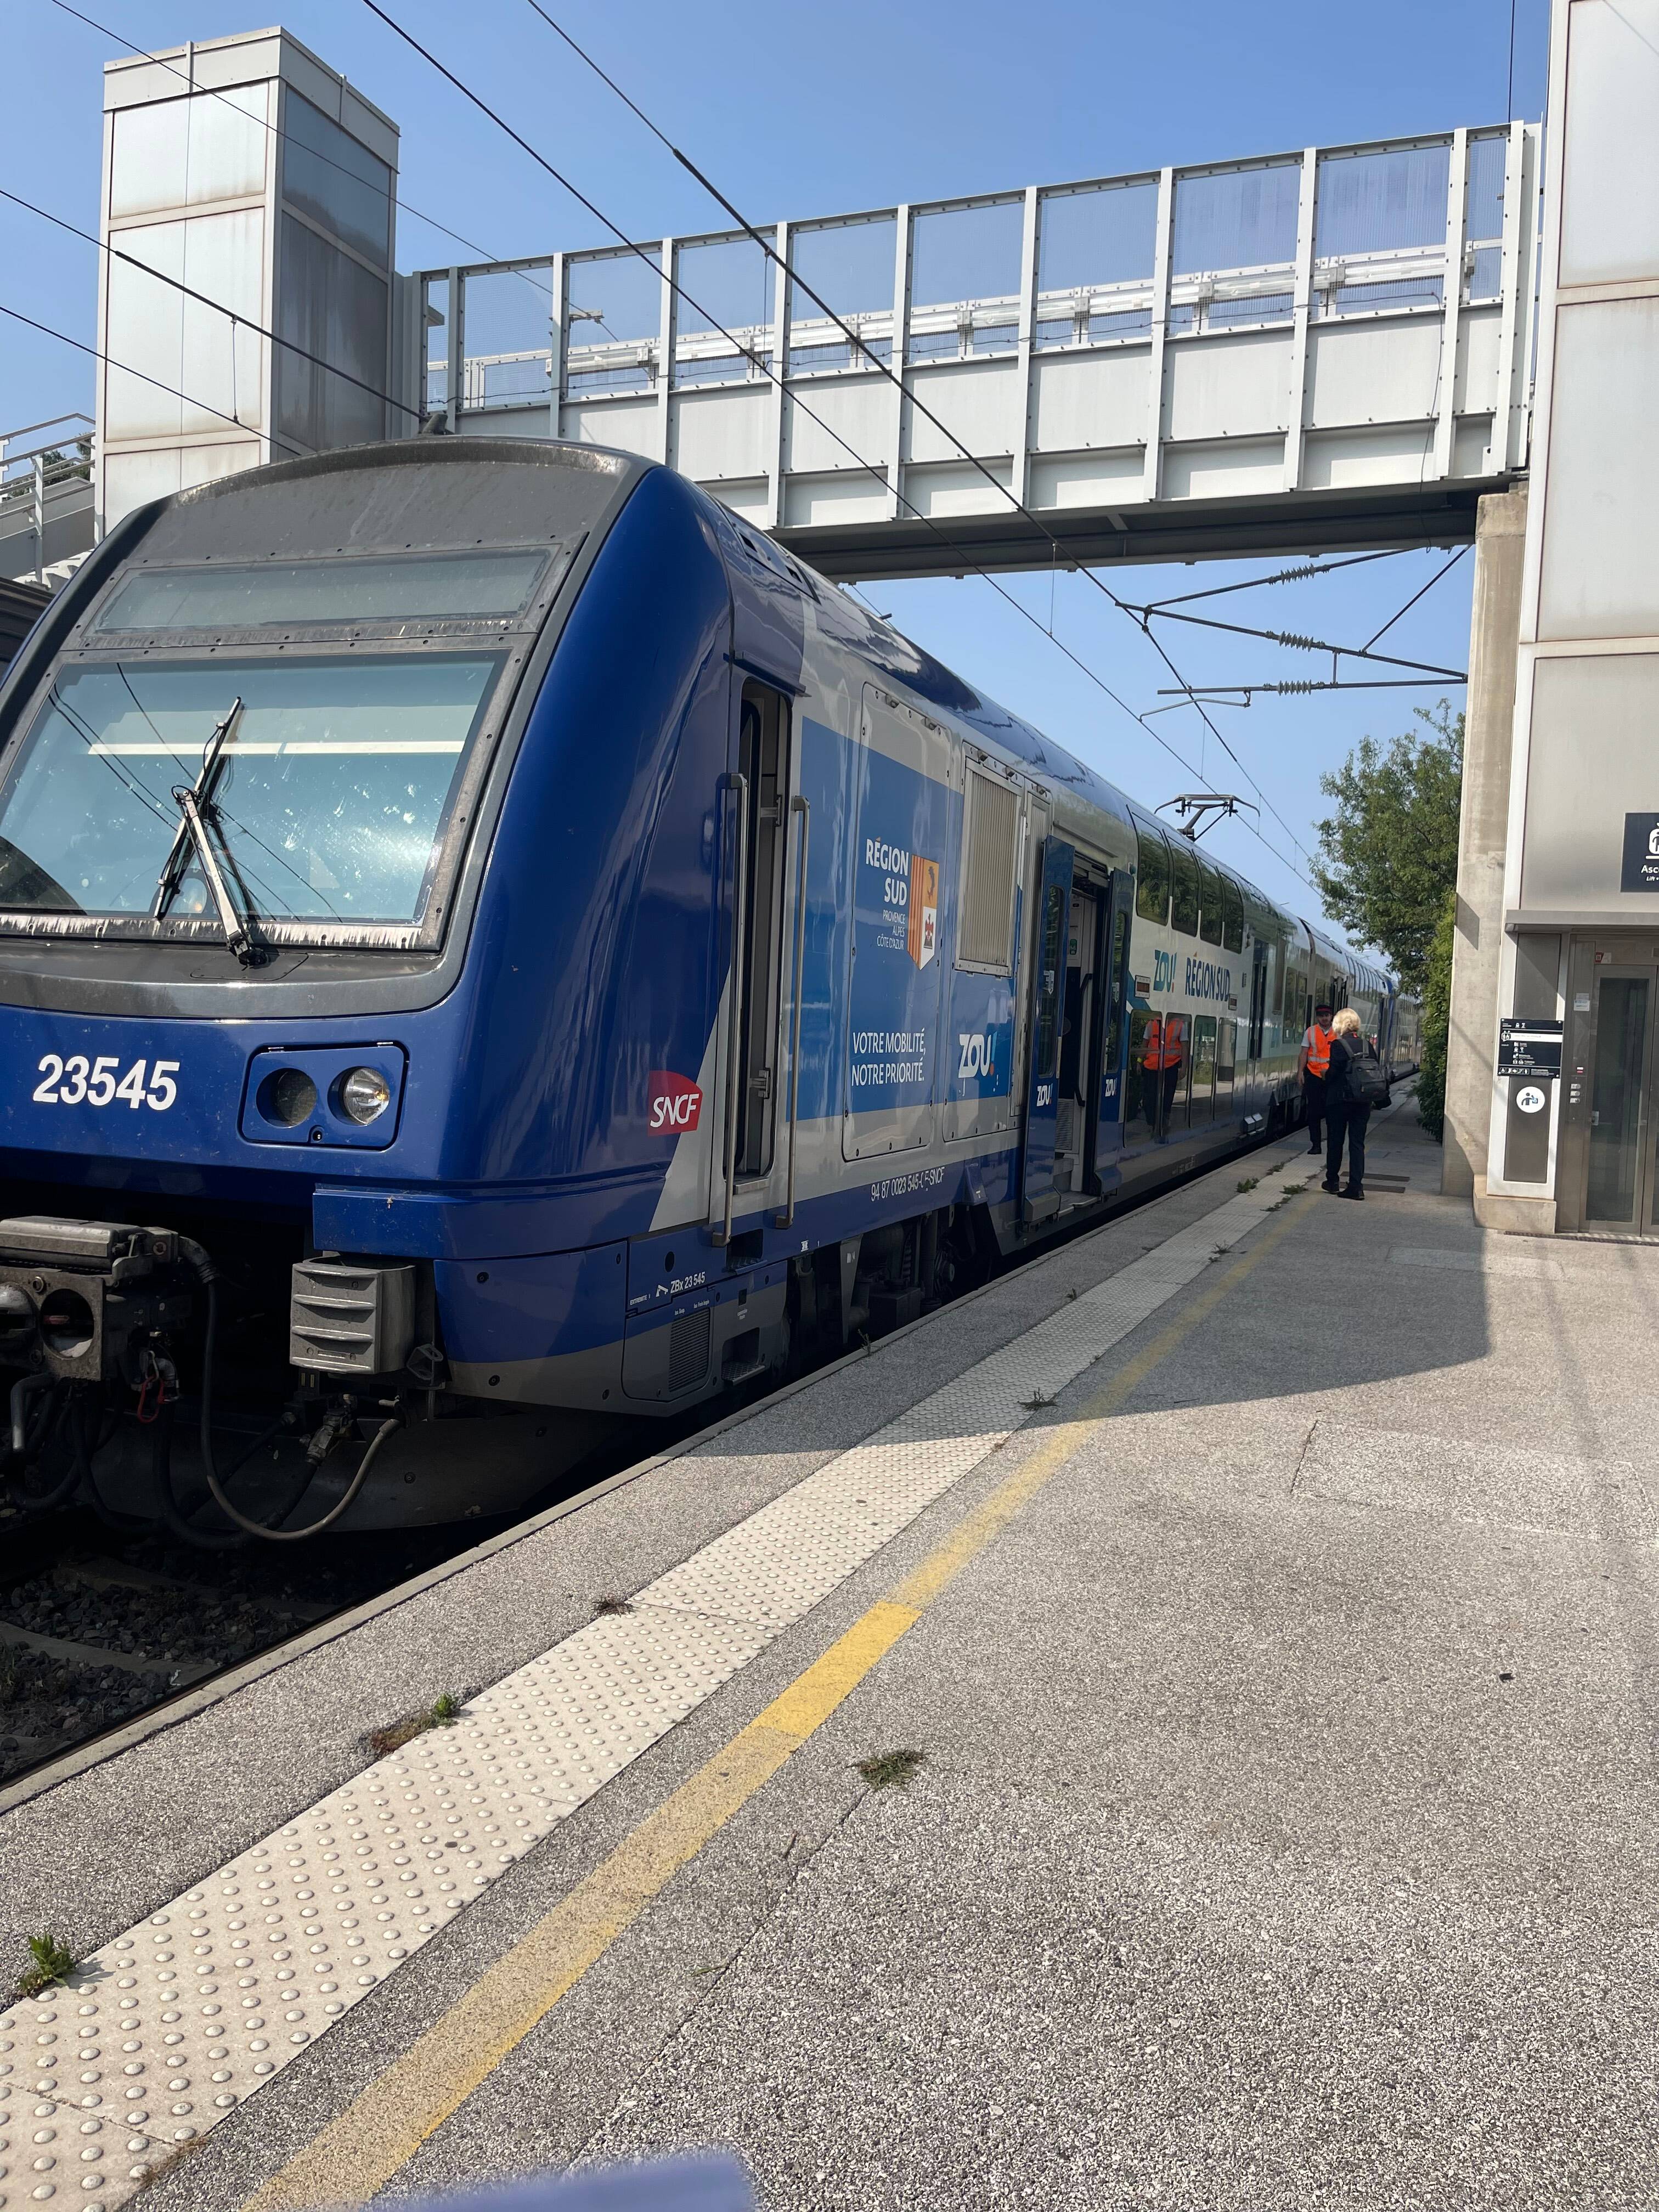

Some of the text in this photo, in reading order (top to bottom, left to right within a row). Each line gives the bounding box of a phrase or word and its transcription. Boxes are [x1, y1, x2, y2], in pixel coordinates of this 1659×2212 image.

[866, 837, 909, 876] RÉGION
[1641, 865, 1659, 873] Asc
[884, 878, 907, 906] SUD
[883, 910, 906, 924] PROVENCE
[877, 933, 904, 950] CÔTE D'AZUR
[892, 926, 905, 938] ALPES
[1153, 949, 1177, 993] ZOU!
[1185, 951, 1231, 1002] RÉGION SUD
[853, 1028, 926, 1056] VOTRE MOBILITÉ,
[958, 1031, 997, 1079] ZOU!
[33, 1054, 180, 1110] 23545
[851, 1057, 924, 1087] NOTRE PRIORITÉ.
[1036, 1083, 1053, 1107] ZOU!
[650, 1093, 699, 1128] SNCF
[871, 1183, 880, 1202] 94
[881, 1180, 890, 1199] 87
[891, 1177, 906, 1196] 0023
[670, 1271, 706, 1294] ZBx 23 545
